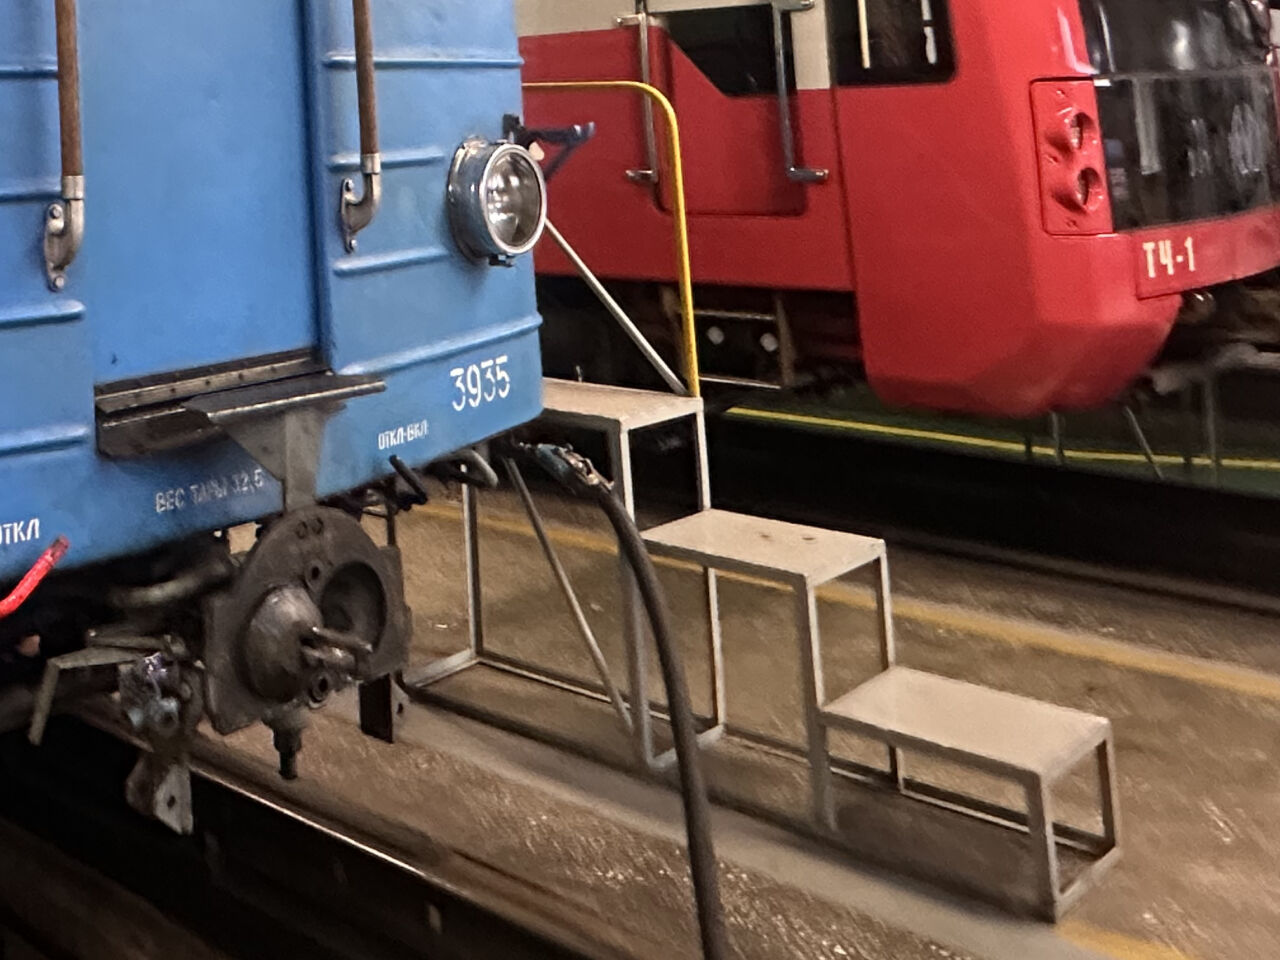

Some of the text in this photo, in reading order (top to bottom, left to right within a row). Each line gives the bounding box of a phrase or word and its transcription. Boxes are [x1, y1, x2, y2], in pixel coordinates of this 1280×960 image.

[1142, 236, 1196, 278] ТЧ-1
[450, 355, 511, 411] 3935
[378, 419, 429, 450] ОТКЛ-ВКЛ
[155, 487, 185, 514] ВЕС
